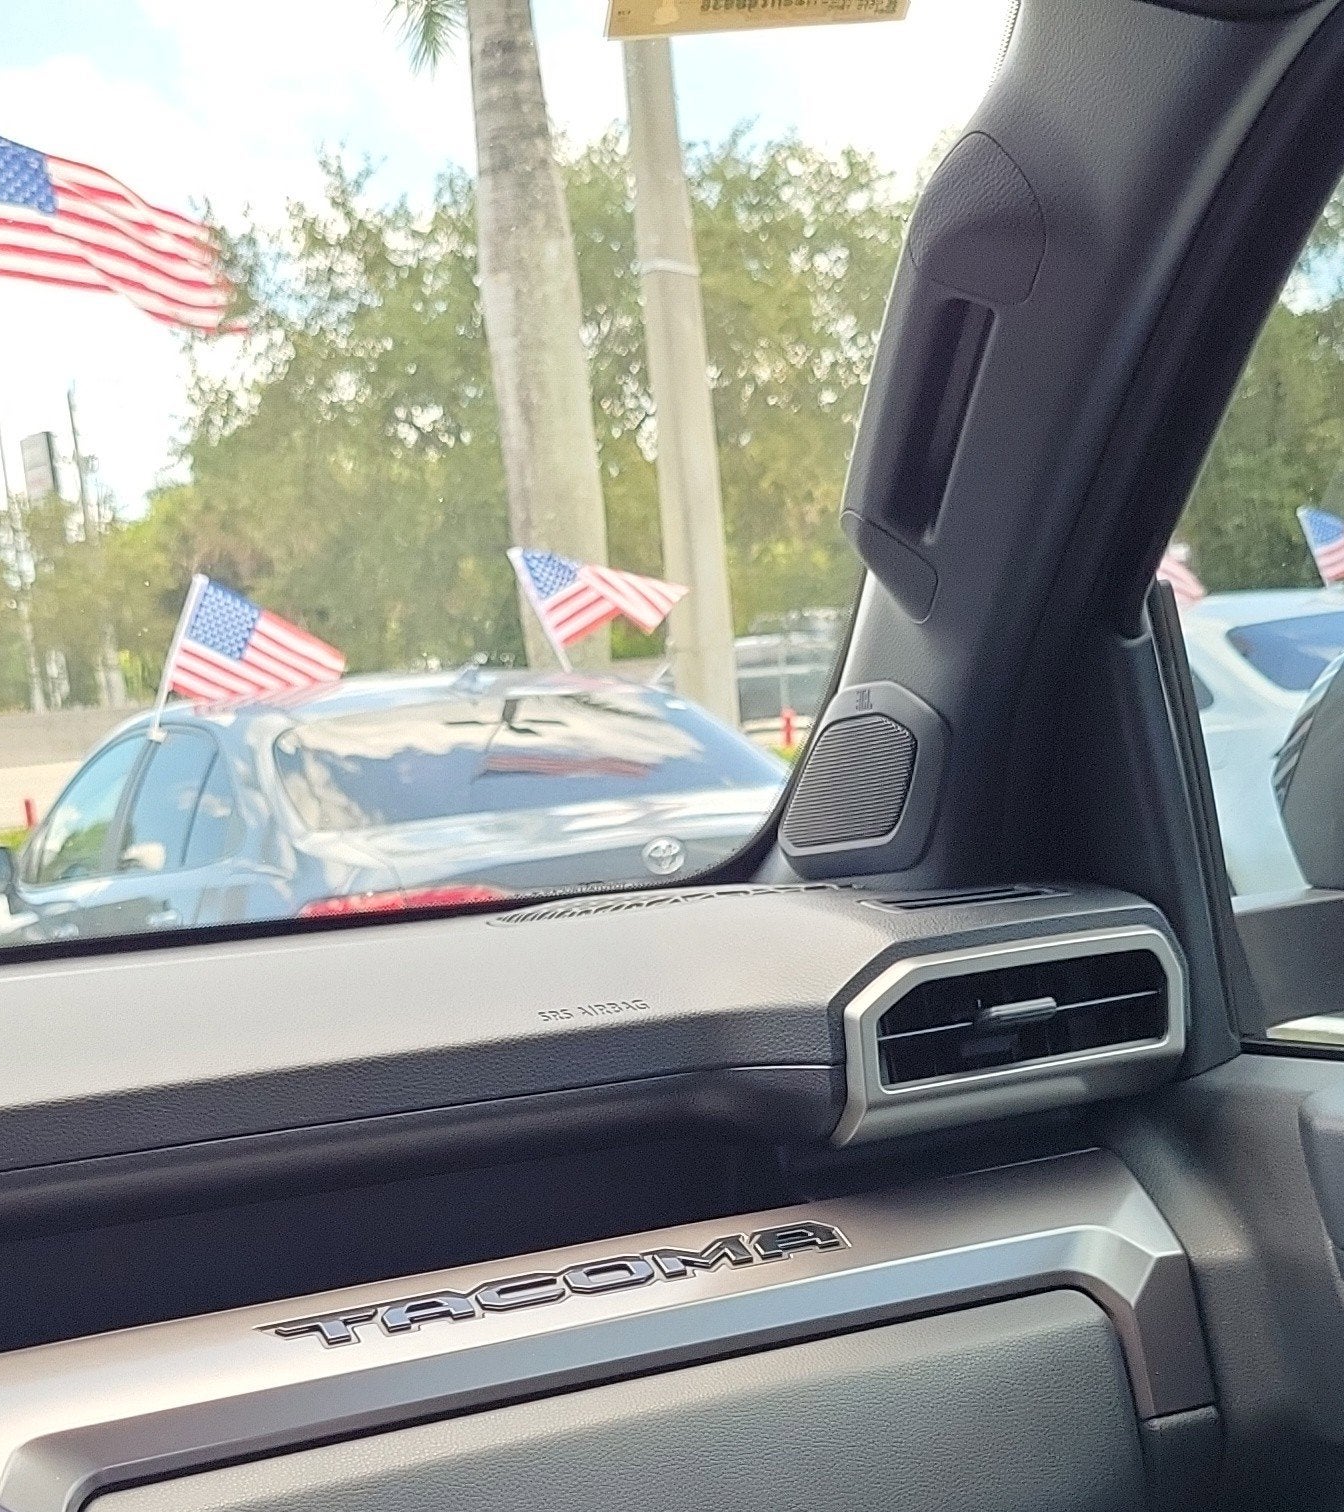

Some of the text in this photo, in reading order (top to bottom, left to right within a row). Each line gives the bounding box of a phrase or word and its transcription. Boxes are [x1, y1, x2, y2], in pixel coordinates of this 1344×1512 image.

[537, 999, 651, 1021] SRS AIRBAG
[260, 1220, 850, 1348] TACOMA
